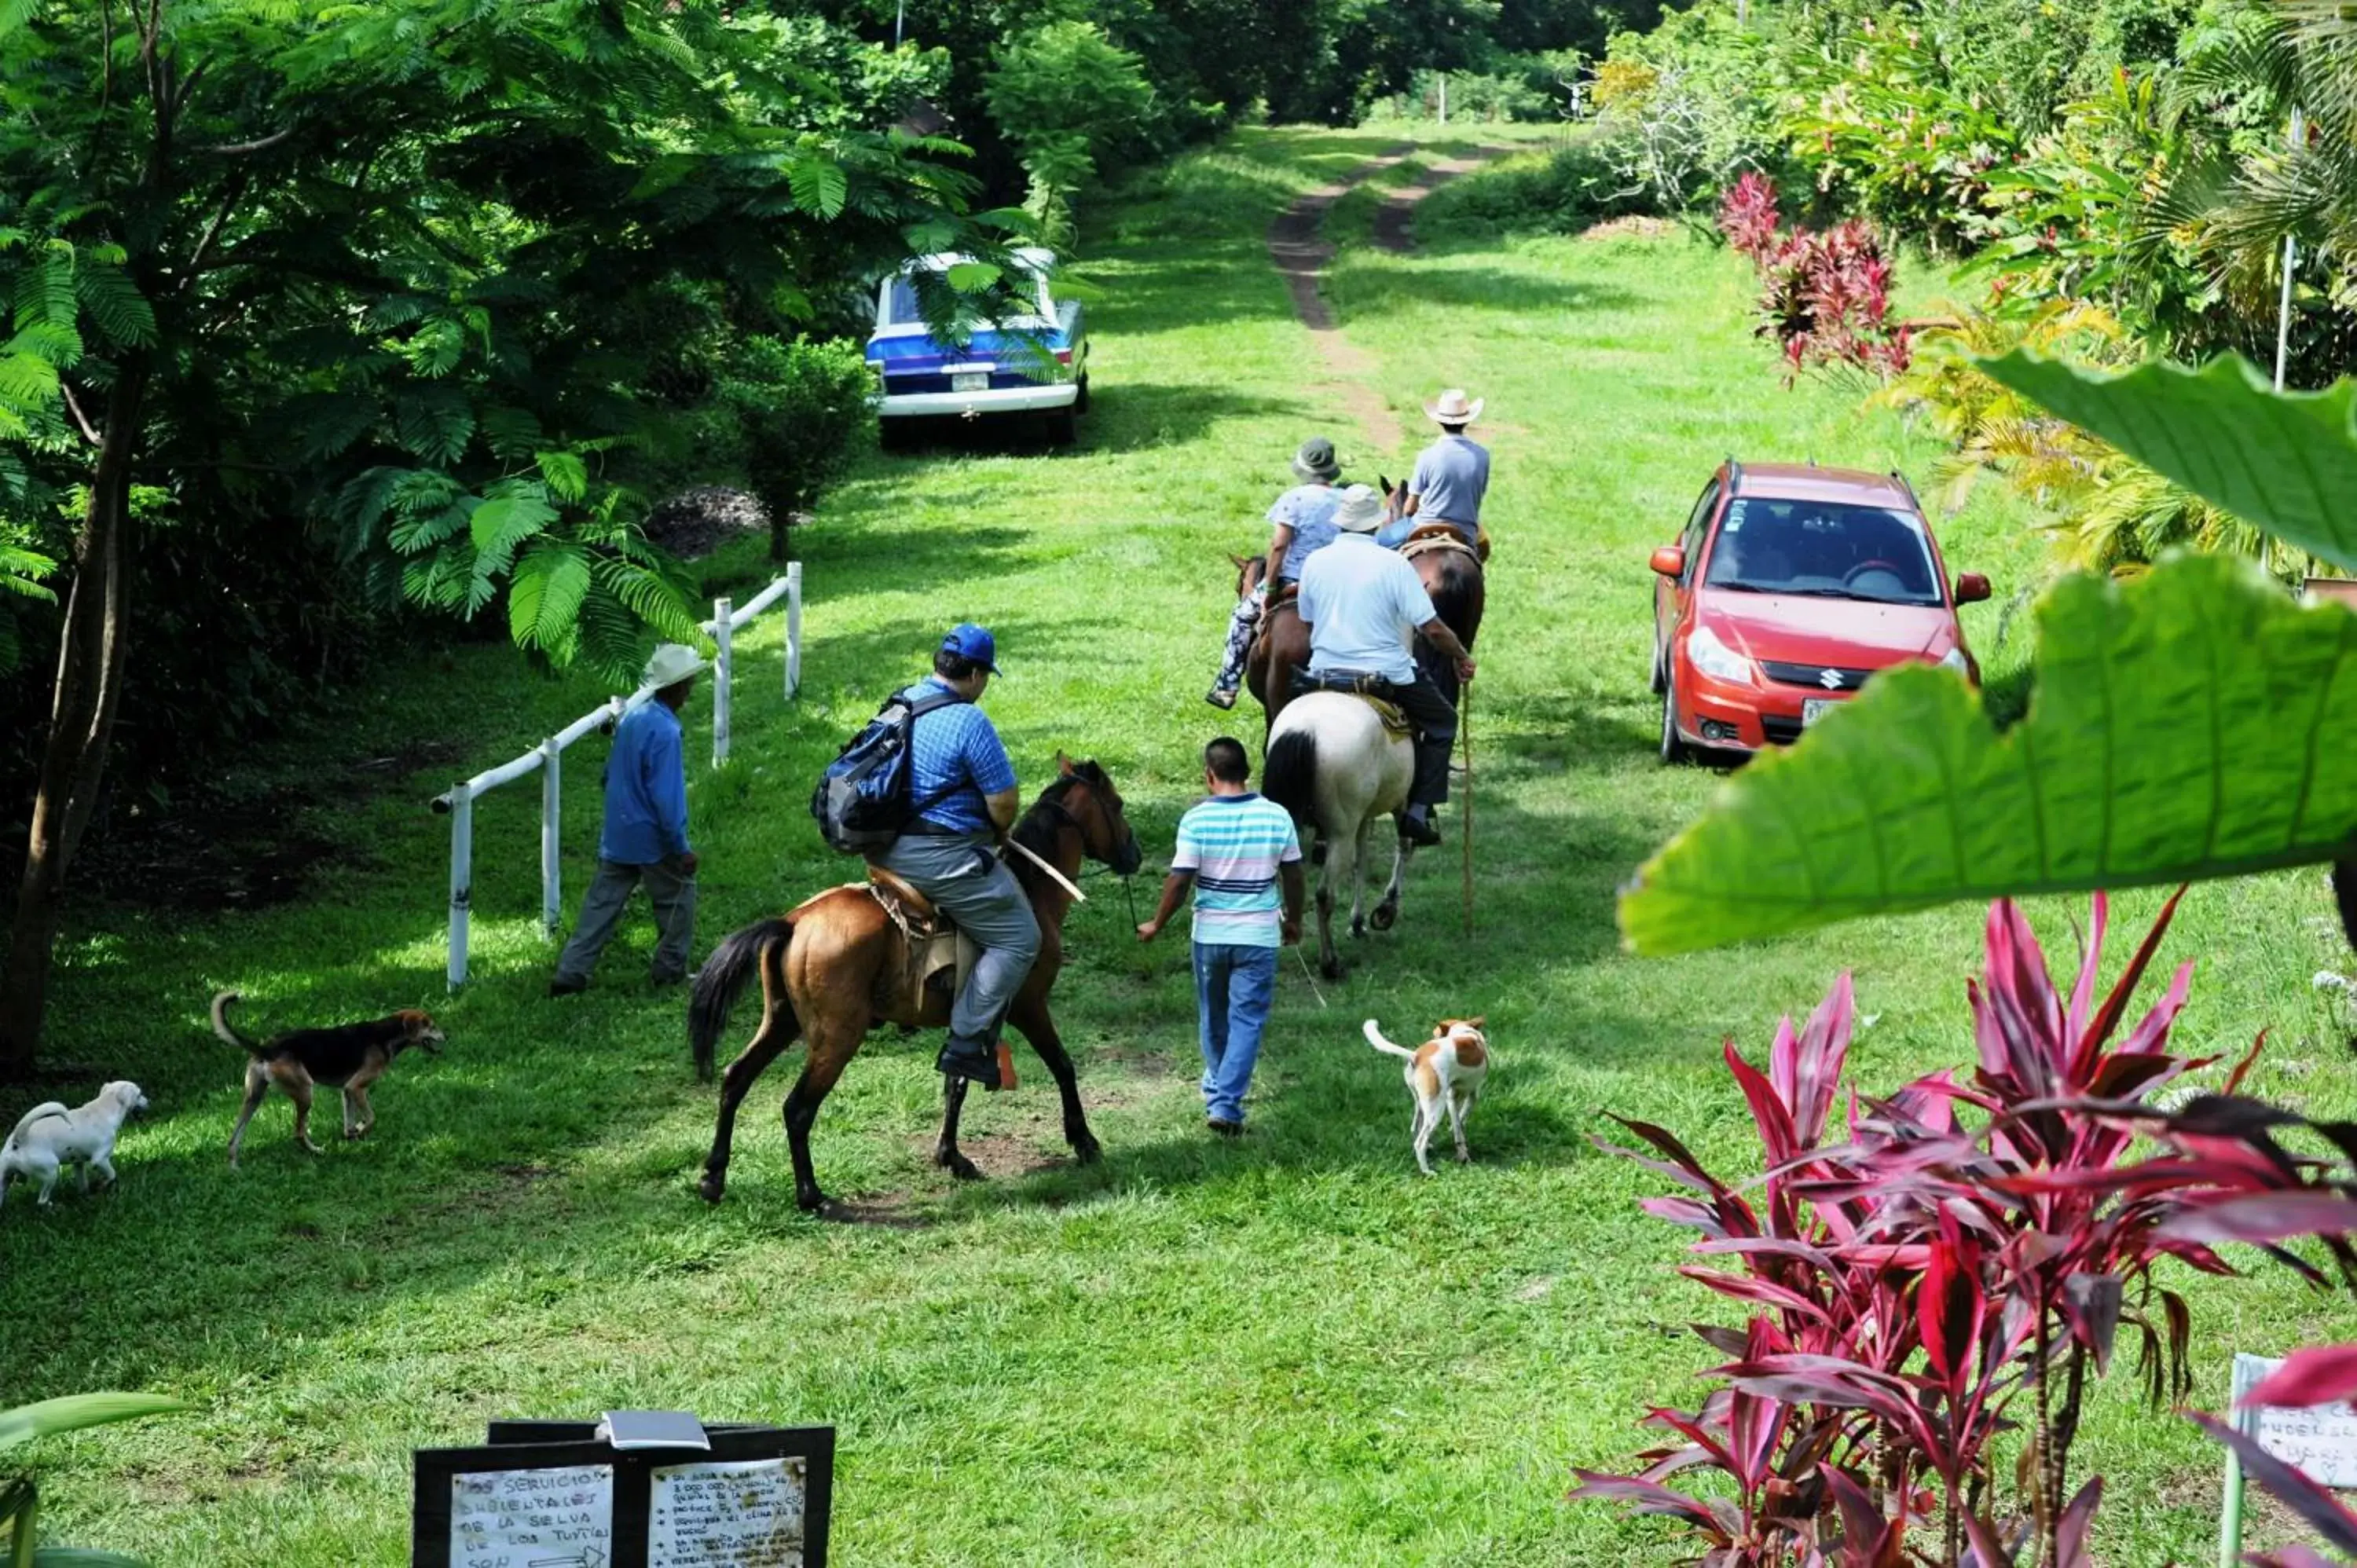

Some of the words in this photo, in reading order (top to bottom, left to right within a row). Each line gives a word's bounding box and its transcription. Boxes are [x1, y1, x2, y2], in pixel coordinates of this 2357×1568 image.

[504, 1471, 603, 1493] SERVICIOS
[459, 1493, 597, 1515] AMBIENTALES
[529, 1511, 592, 1528] SELVA
